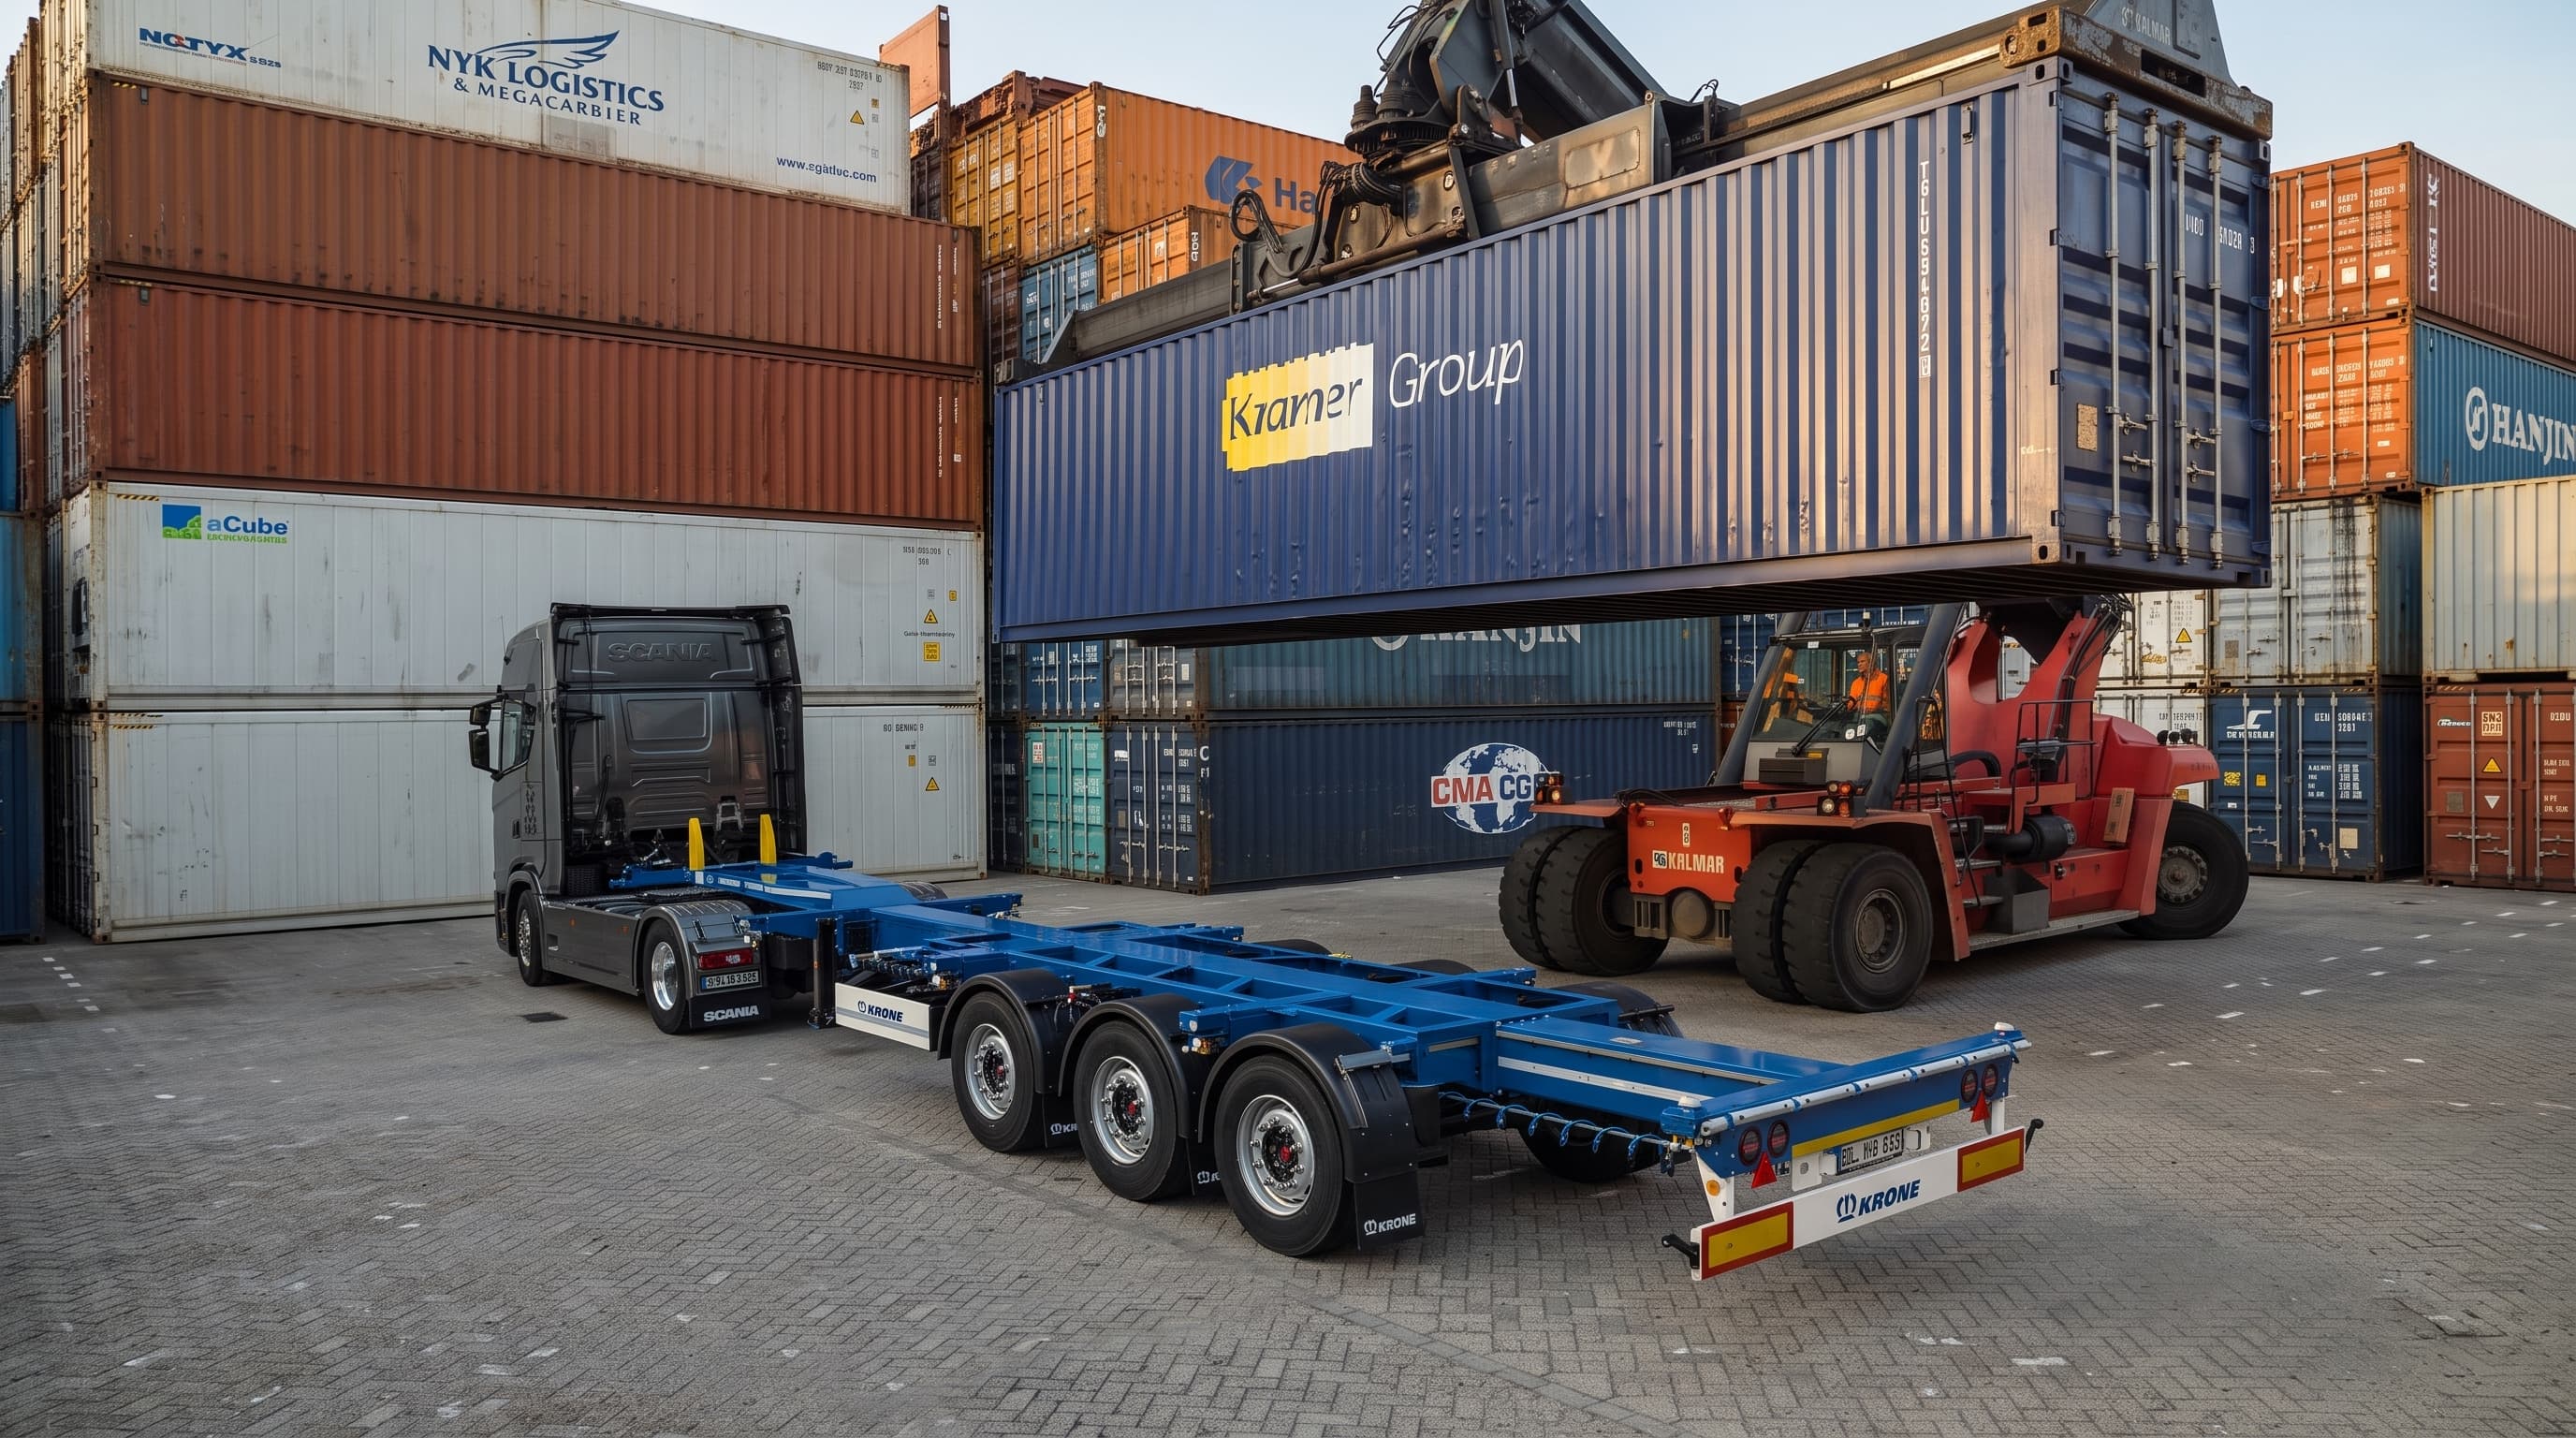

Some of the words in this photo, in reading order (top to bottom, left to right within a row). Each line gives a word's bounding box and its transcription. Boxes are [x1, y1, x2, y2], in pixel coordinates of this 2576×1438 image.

[428, 45, 496, 81] NYK
[507, 61, 665, 111] LOGISTICS
[454, 77, 469, 93] &
[477, 81, 641, 125] MEGACARBIER
[1389, 339, 1525, 409] Group
[206, 515, 288, 536] aCube
[607, 642, 718, 662] SCANIA
[1432, 775, 1494, 805] CMA
[1500, 773, 1540, 800] CG
[1668, 852, 1724, 873] KALMAR
[703, 1005, 760, 1022] SCANIA
[867, 1004, 904, 1023] KRONE
[1858, 1179, 1921, 1217] KRONE
[1378, 1212, 1416, 1233] KRONE
